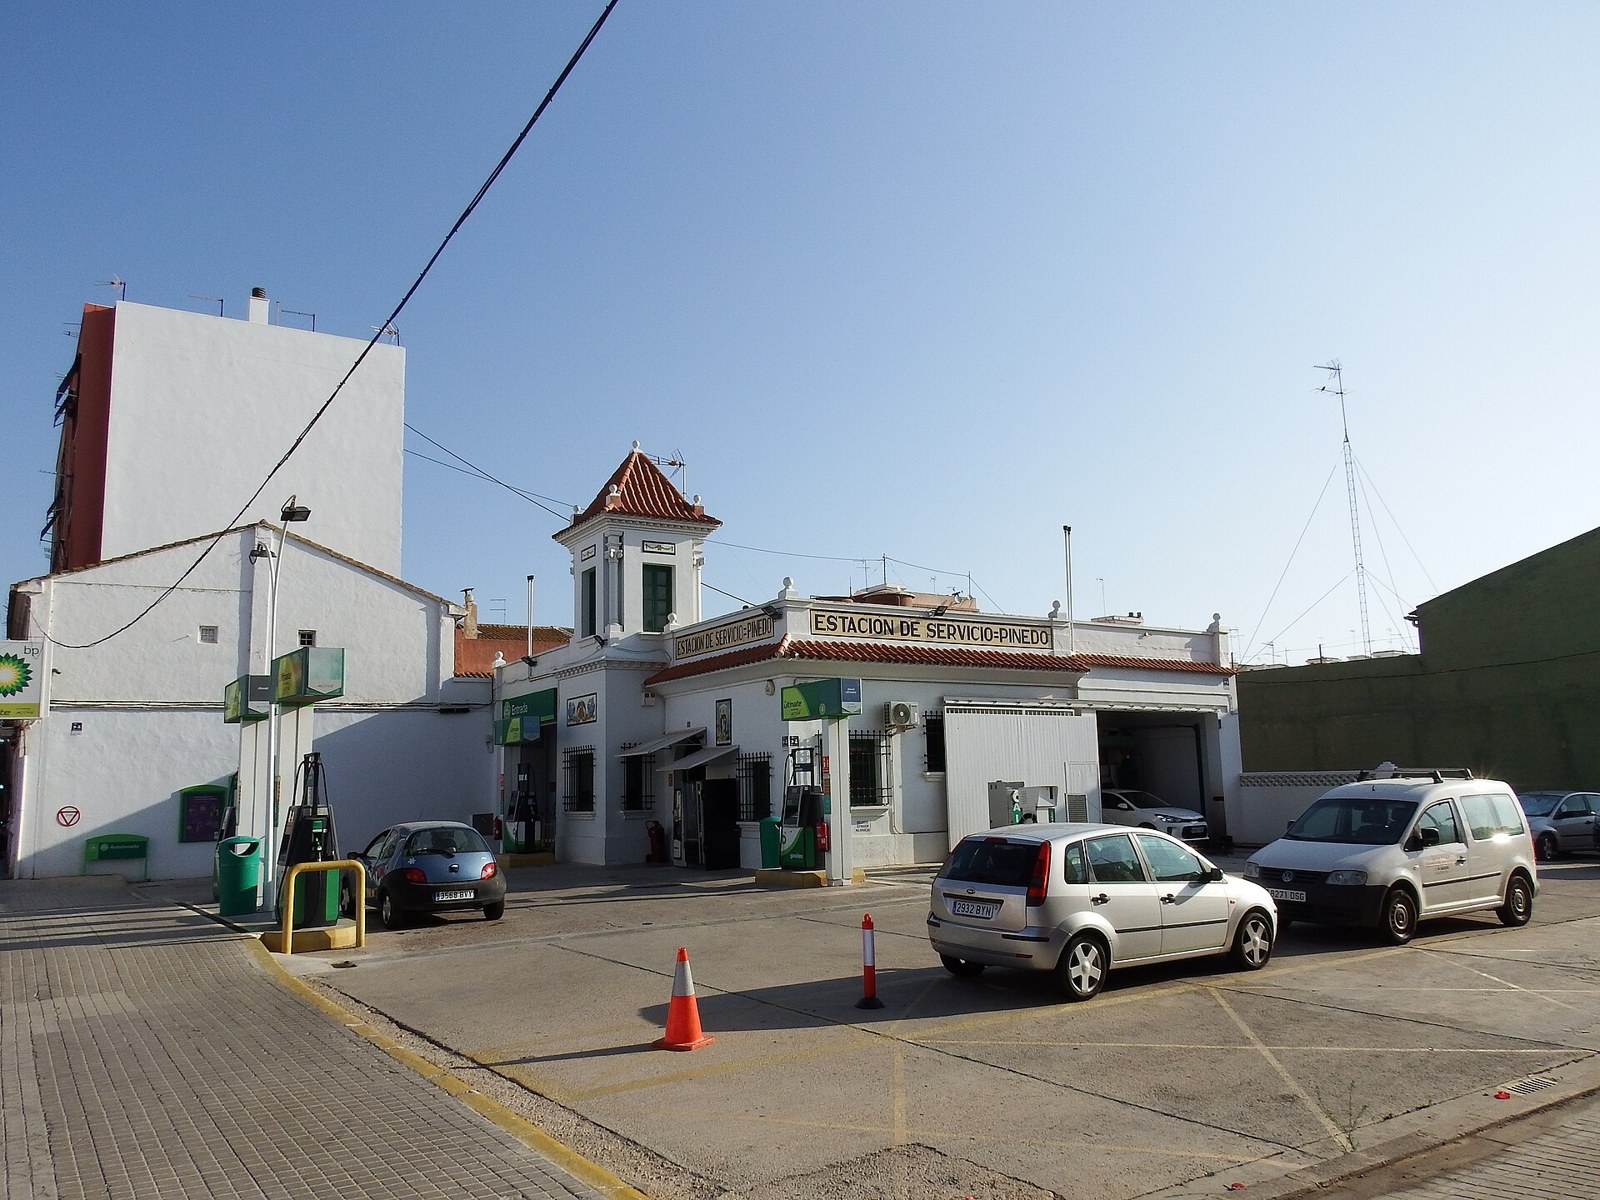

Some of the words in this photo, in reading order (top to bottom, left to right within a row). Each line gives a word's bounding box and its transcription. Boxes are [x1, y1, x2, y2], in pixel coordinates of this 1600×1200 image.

[814, 614, 894, 635] ESTACION
[900, 620, 921, 637] DE
[23, 645, 40, 657] bp
[677, 633, 705, 656] ESTACION
[705, 632, 714, 649] DE
[511, 702, 529, 716] Entrada
[1270, 889, 1288, 899] 8271
[1290, 891, 1305, 901] DSG
[956, 902, 975, 914] 2932
[975, 904, 992, 917] BYN
